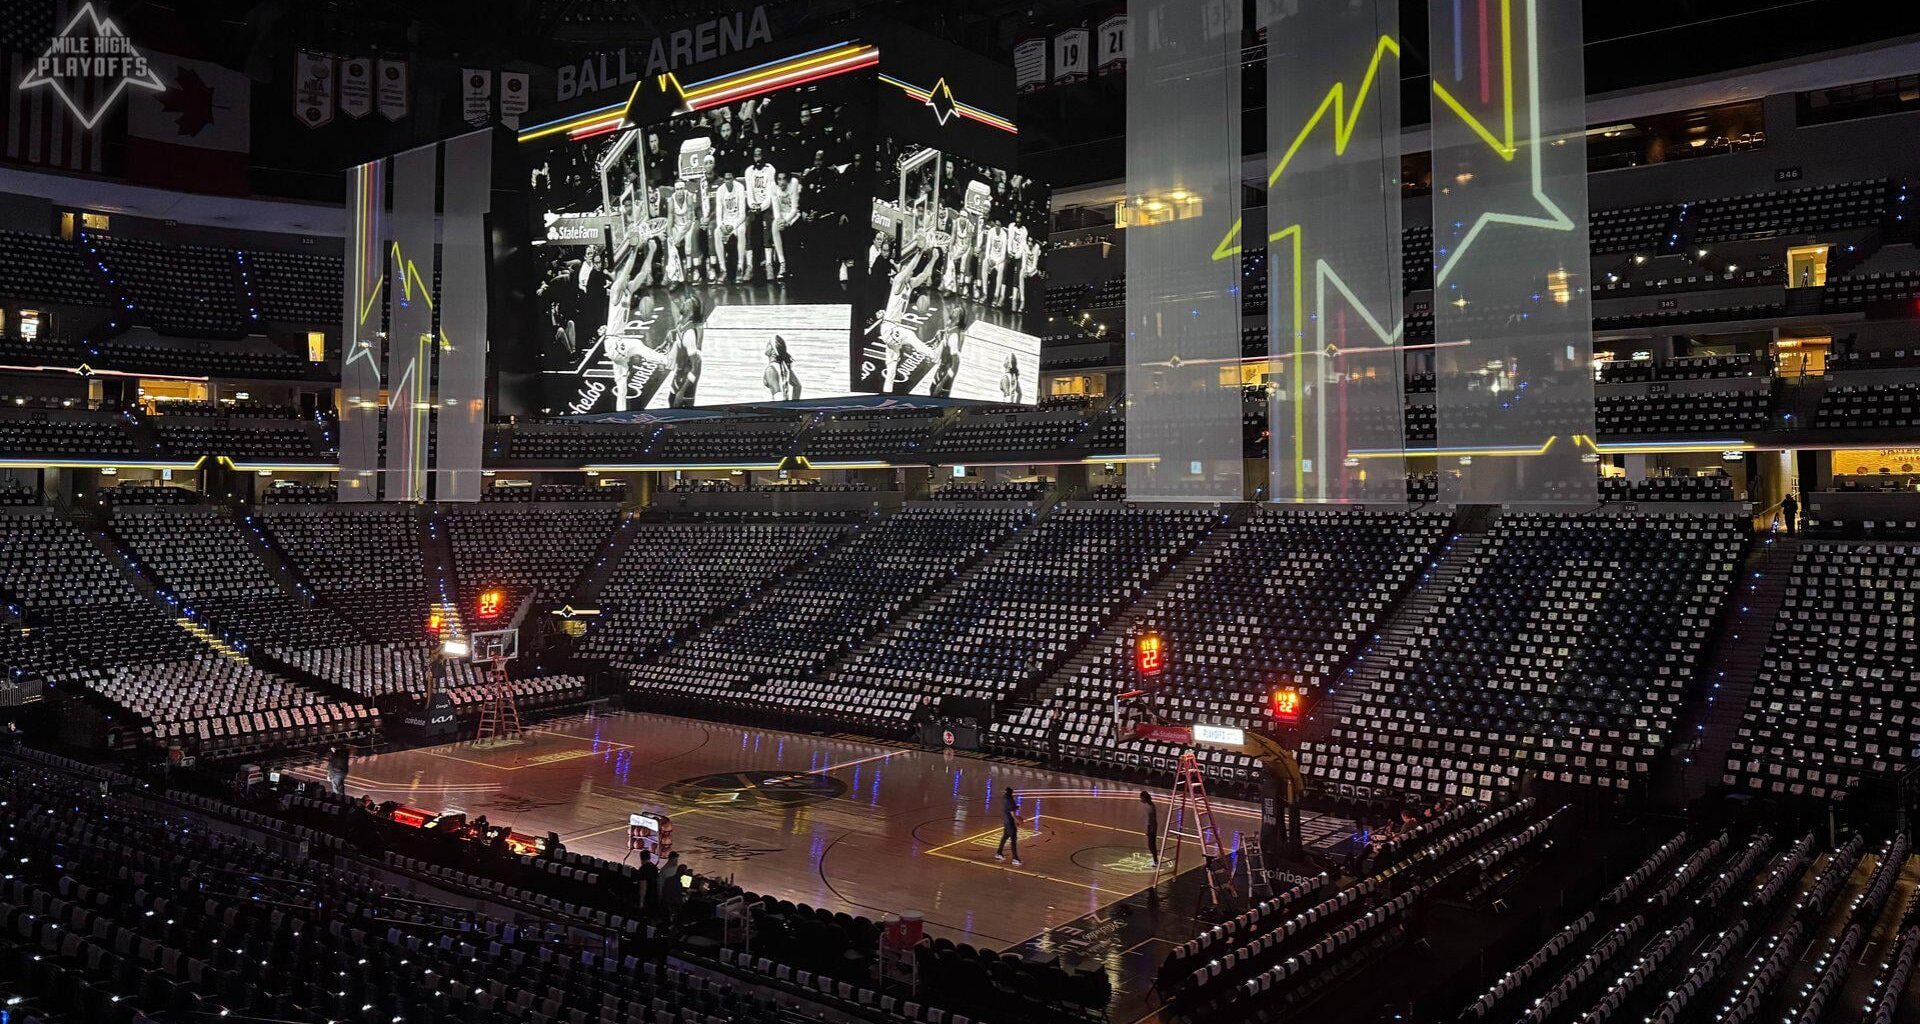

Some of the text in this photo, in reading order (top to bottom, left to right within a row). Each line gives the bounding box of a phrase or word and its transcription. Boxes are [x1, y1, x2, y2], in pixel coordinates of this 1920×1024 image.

[1109, 30, 1124, 53] 21
[556, 5, 774, 103] BALL ARENA
[1063, 44, 1078, 67] 19
[1778, 169, 1799, 180] 346
[872, 209, 891, 229] Farm
[481, 601, 497, 614] 22
[1142, 650, 1158, 669] 22
[1279, 701, 1293, 713] 22
